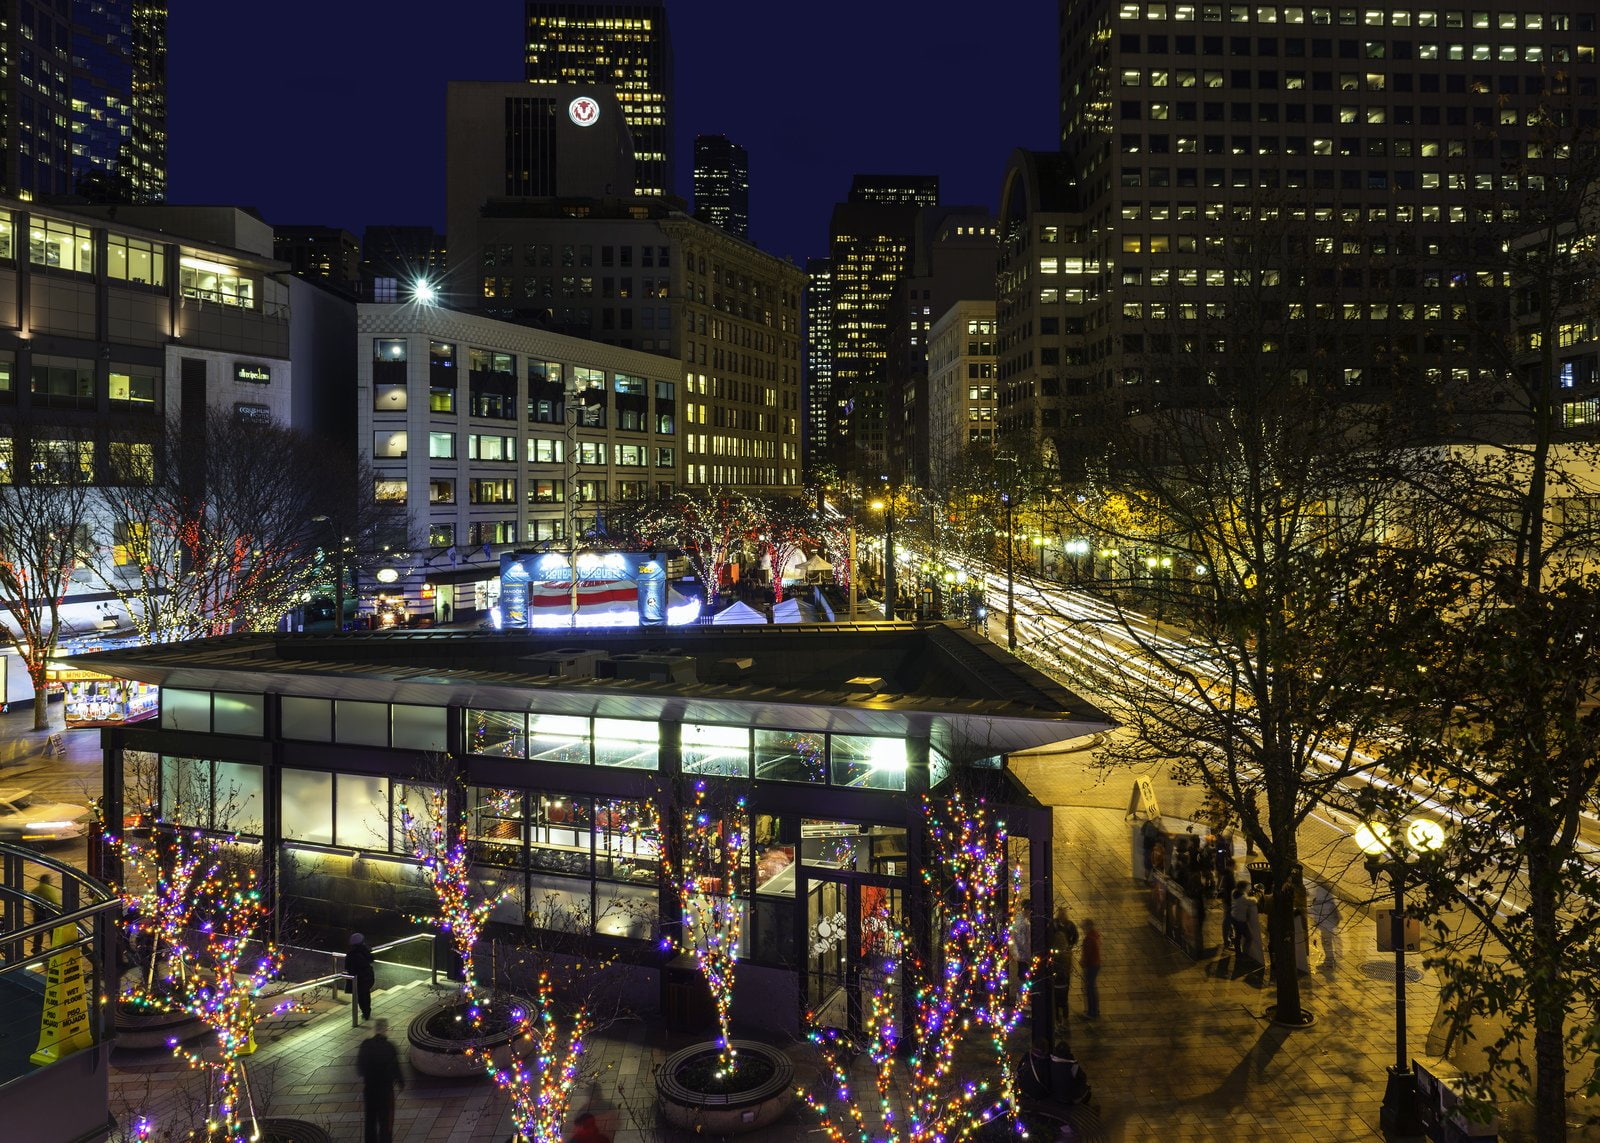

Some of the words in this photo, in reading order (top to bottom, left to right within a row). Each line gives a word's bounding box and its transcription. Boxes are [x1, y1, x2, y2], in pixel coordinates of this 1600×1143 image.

[67, 987, 79, 996] WET
[64, 994, 82, 1005] FLOOR
[67, 1008, 80, 1017] PISO
[62, 1014, 86, 1027] MOJADO
